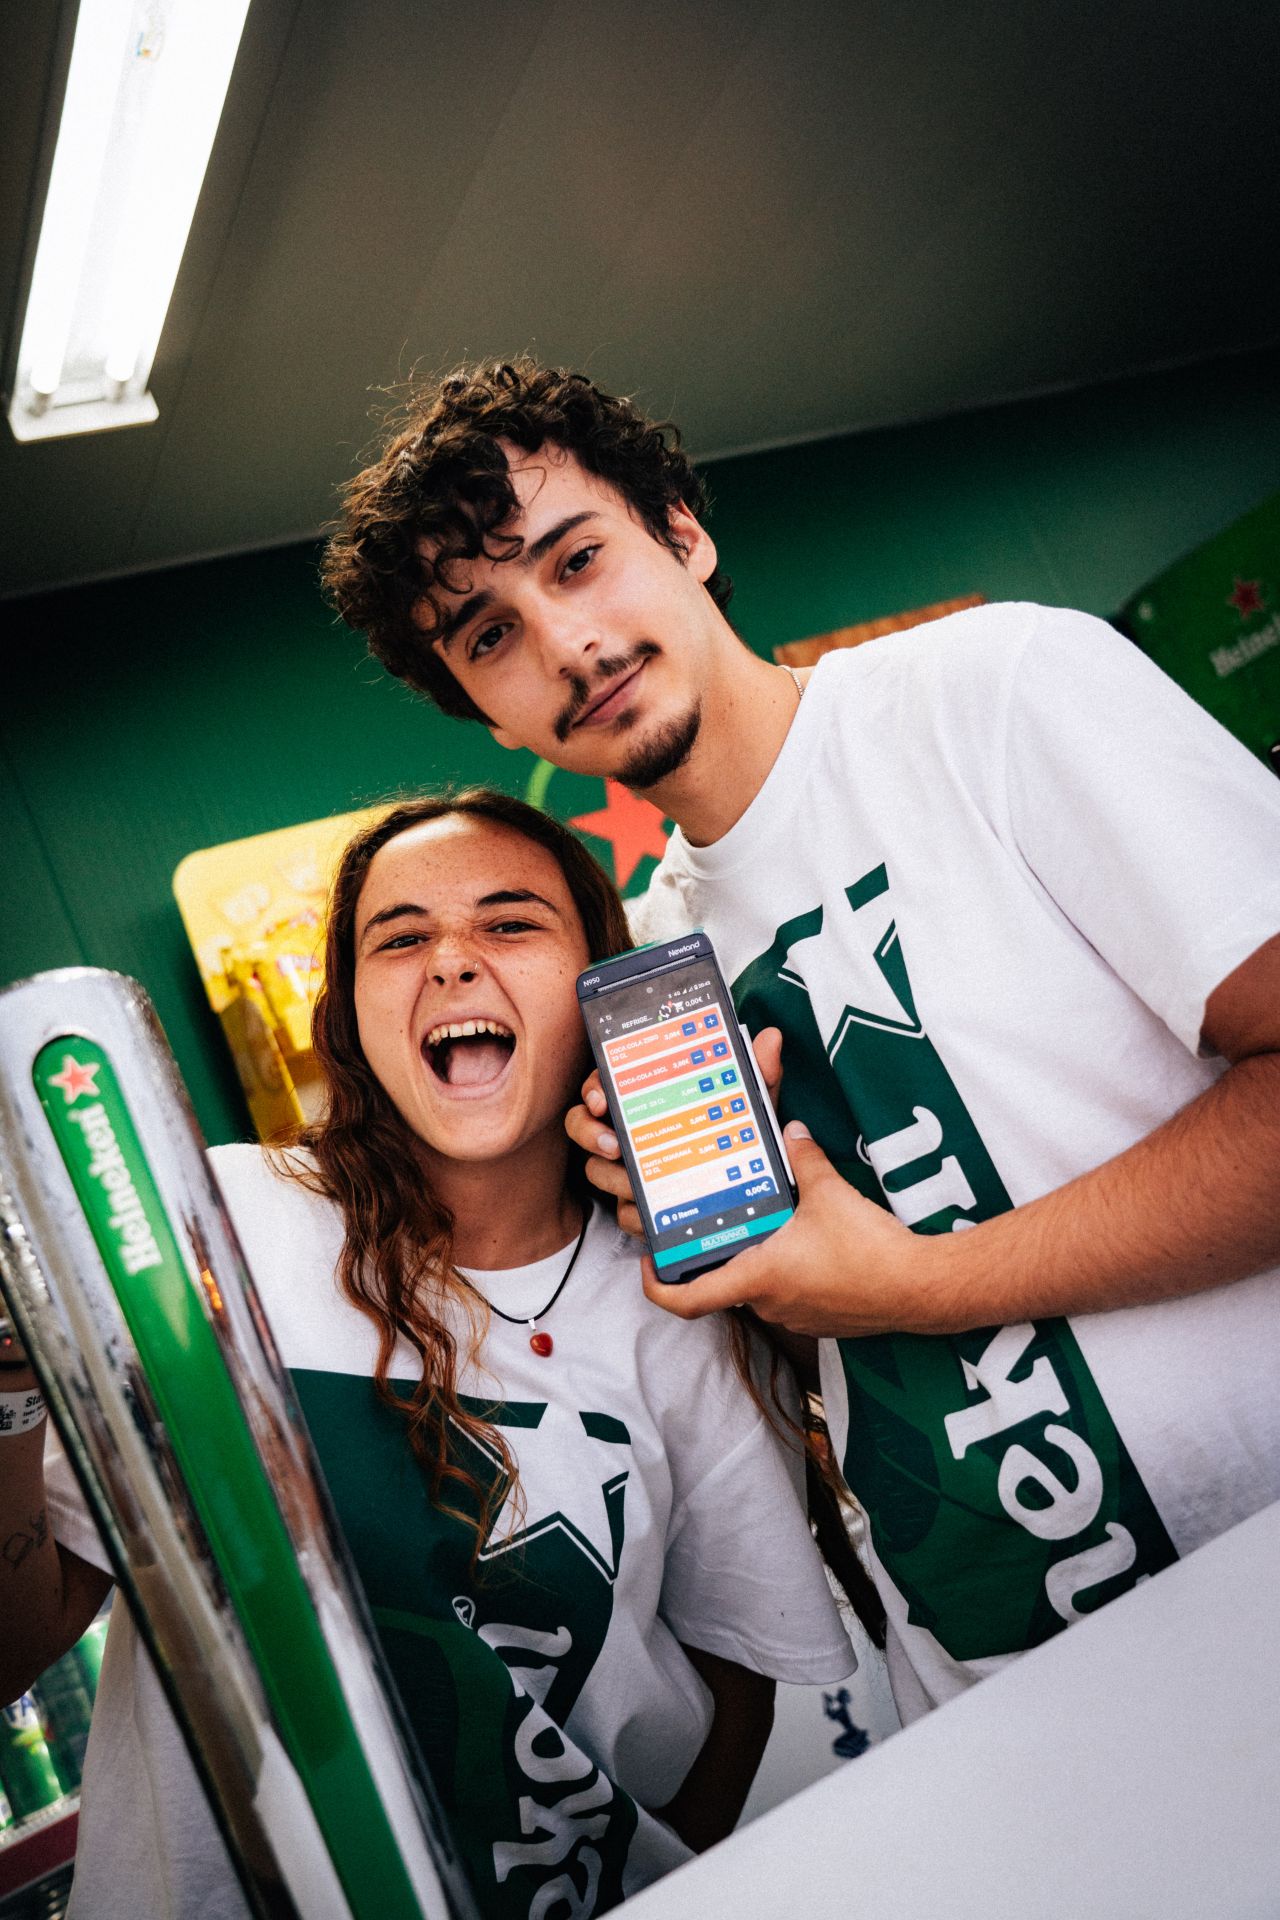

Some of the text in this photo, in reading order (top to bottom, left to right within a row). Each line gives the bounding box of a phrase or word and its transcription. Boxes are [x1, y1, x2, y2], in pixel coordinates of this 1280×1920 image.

[668, 940, 700, 958] Newland
[583, 976, 600, 988] N950
[745, 1181, 771, 1197] 0,00€
